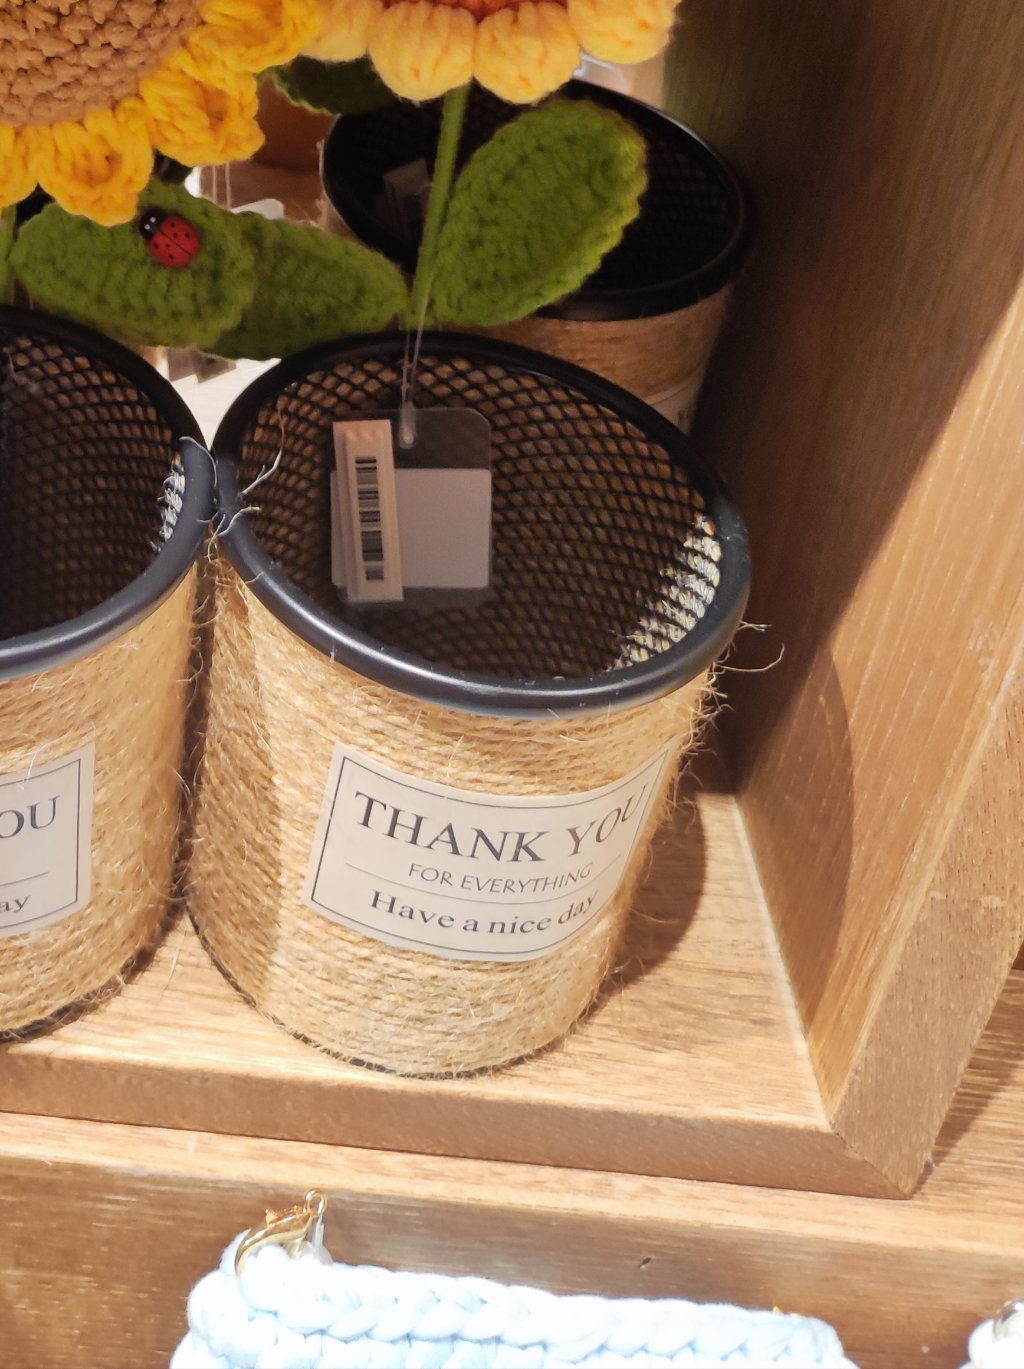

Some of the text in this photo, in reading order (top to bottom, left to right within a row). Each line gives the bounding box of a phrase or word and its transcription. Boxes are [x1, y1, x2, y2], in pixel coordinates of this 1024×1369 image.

[354, 782, 649, 863] THANK YOU
[408, 861, 595, 895] FOR EVERYTHING
[370, 889, 599, 934] Have a nice day
